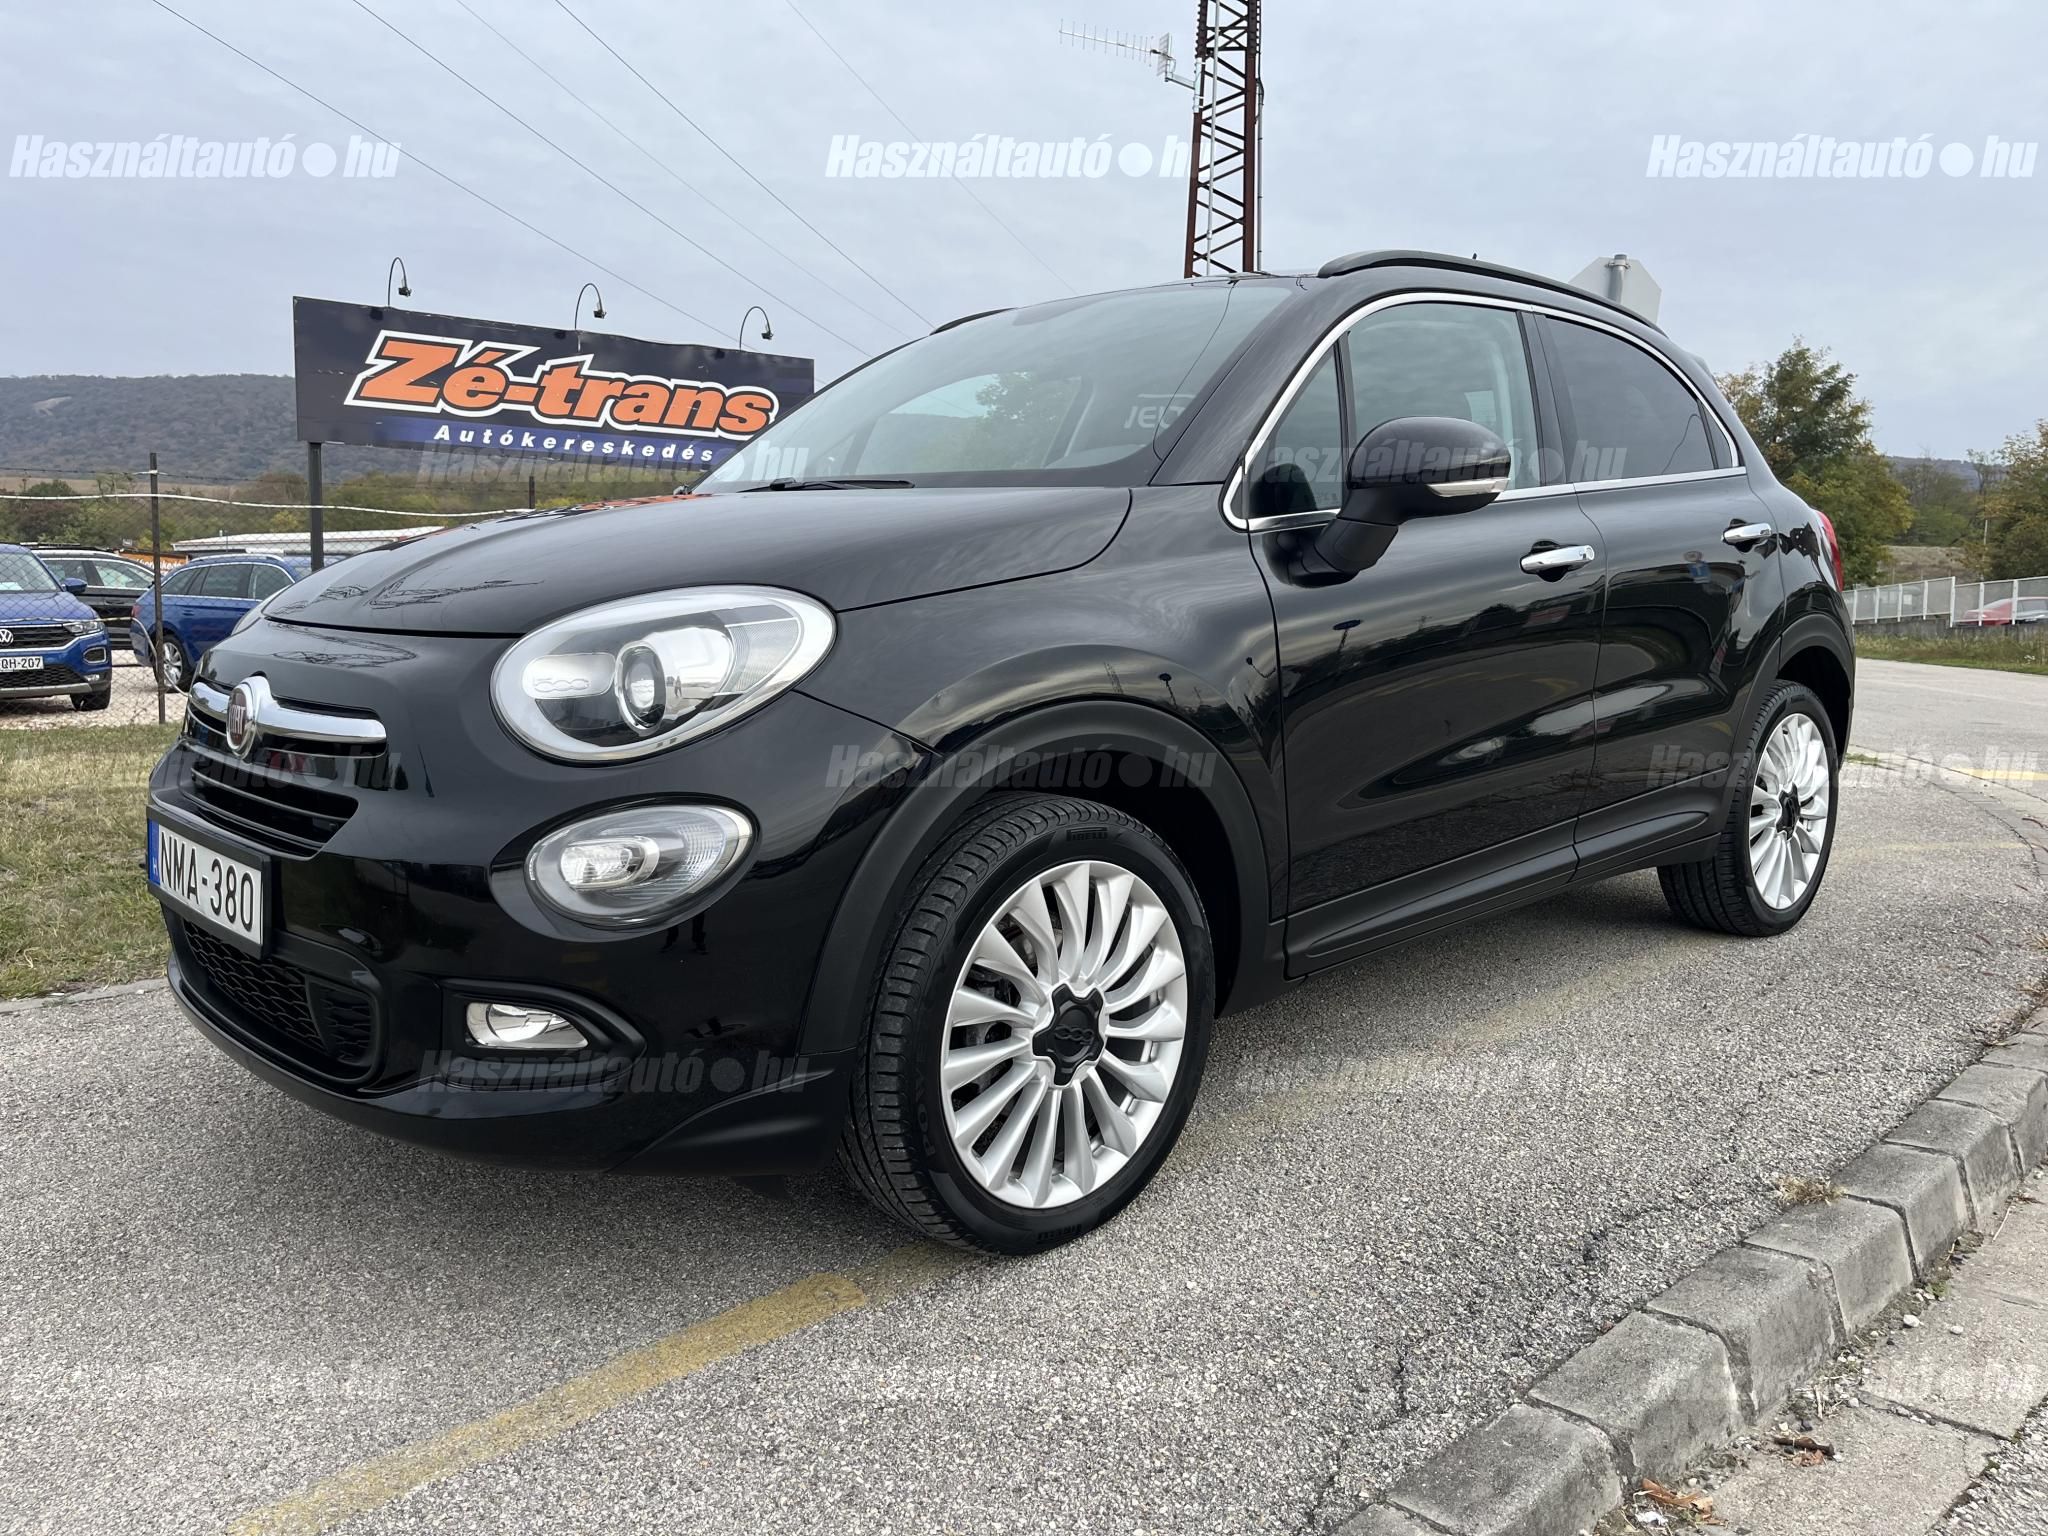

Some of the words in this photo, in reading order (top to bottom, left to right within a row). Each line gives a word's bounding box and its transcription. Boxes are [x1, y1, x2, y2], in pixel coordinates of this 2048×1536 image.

[353, 336, 777, 437] Zé-trans
[434, 424, 714, 462] Autókereskedés
[1, 657, 41, 669] QH-207
[228, 704, 247, 735] FIAT
[160, 831, 255, 933] NMA-380
